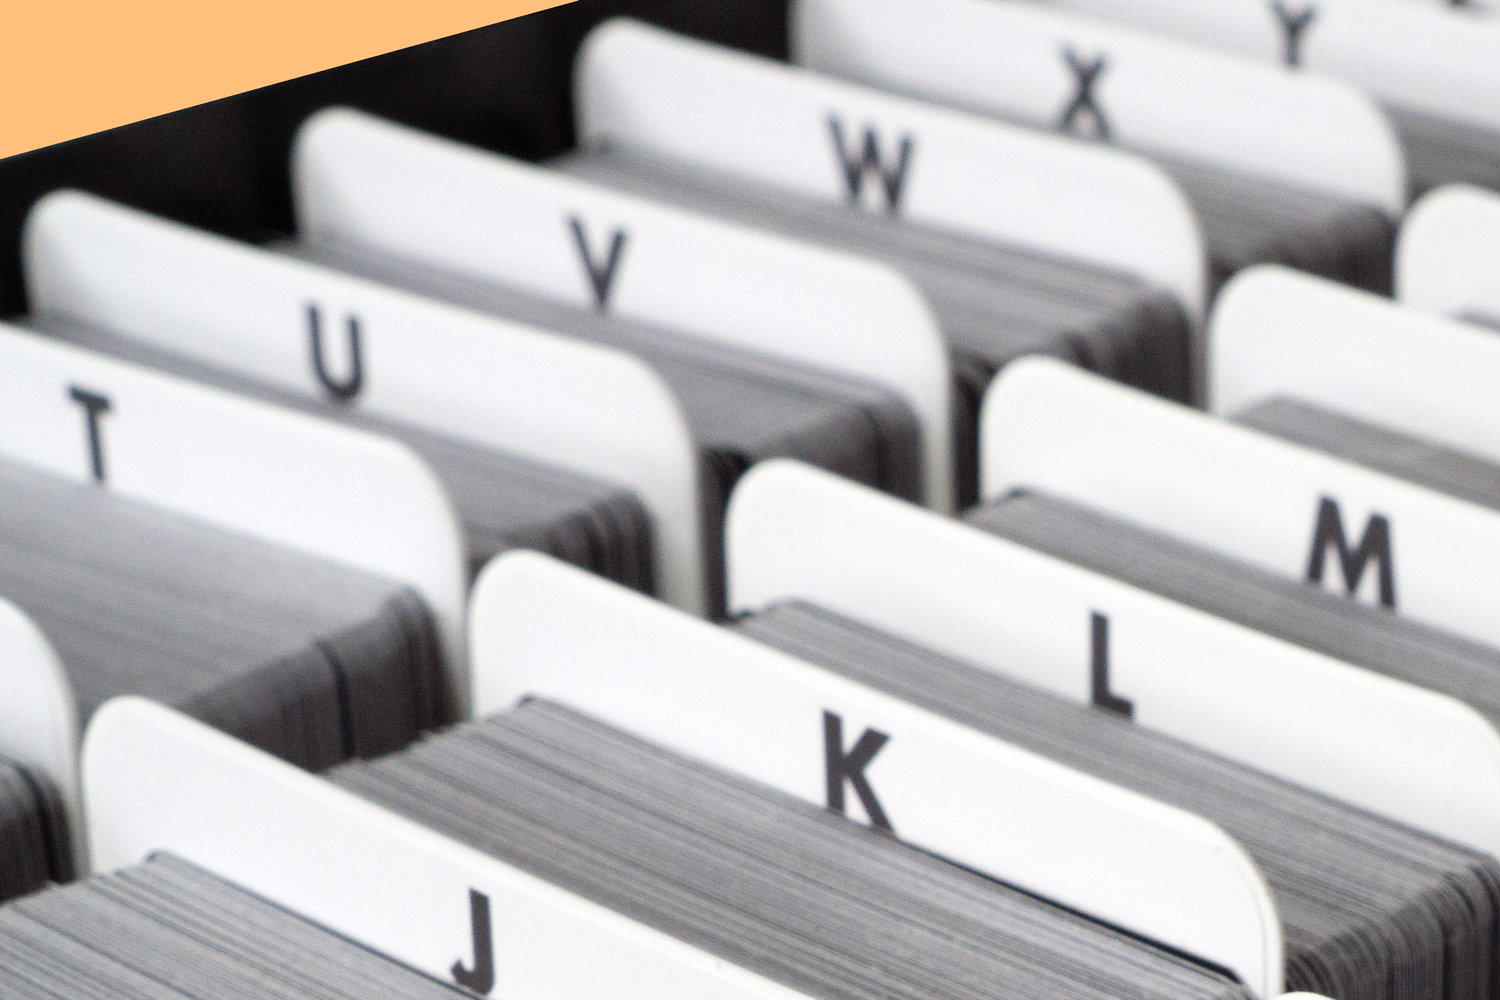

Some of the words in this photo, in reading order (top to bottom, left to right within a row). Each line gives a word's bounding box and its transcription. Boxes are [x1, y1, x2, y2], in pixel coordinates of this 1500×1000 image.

[1270, 0, 1317, 68] Y
[1059, 46, 1110, 140] X
[828, 113, 913, 214] W
[568, 213, 627, 309] V
[305, 303, 366, 403] U
[68, 386, 112, 483] T
[1306, 498, 1396, 610] M
[1089, 612, 1134, 718] L
[822, 711, 894, 828] K
[450, 888, 495, 996] J
